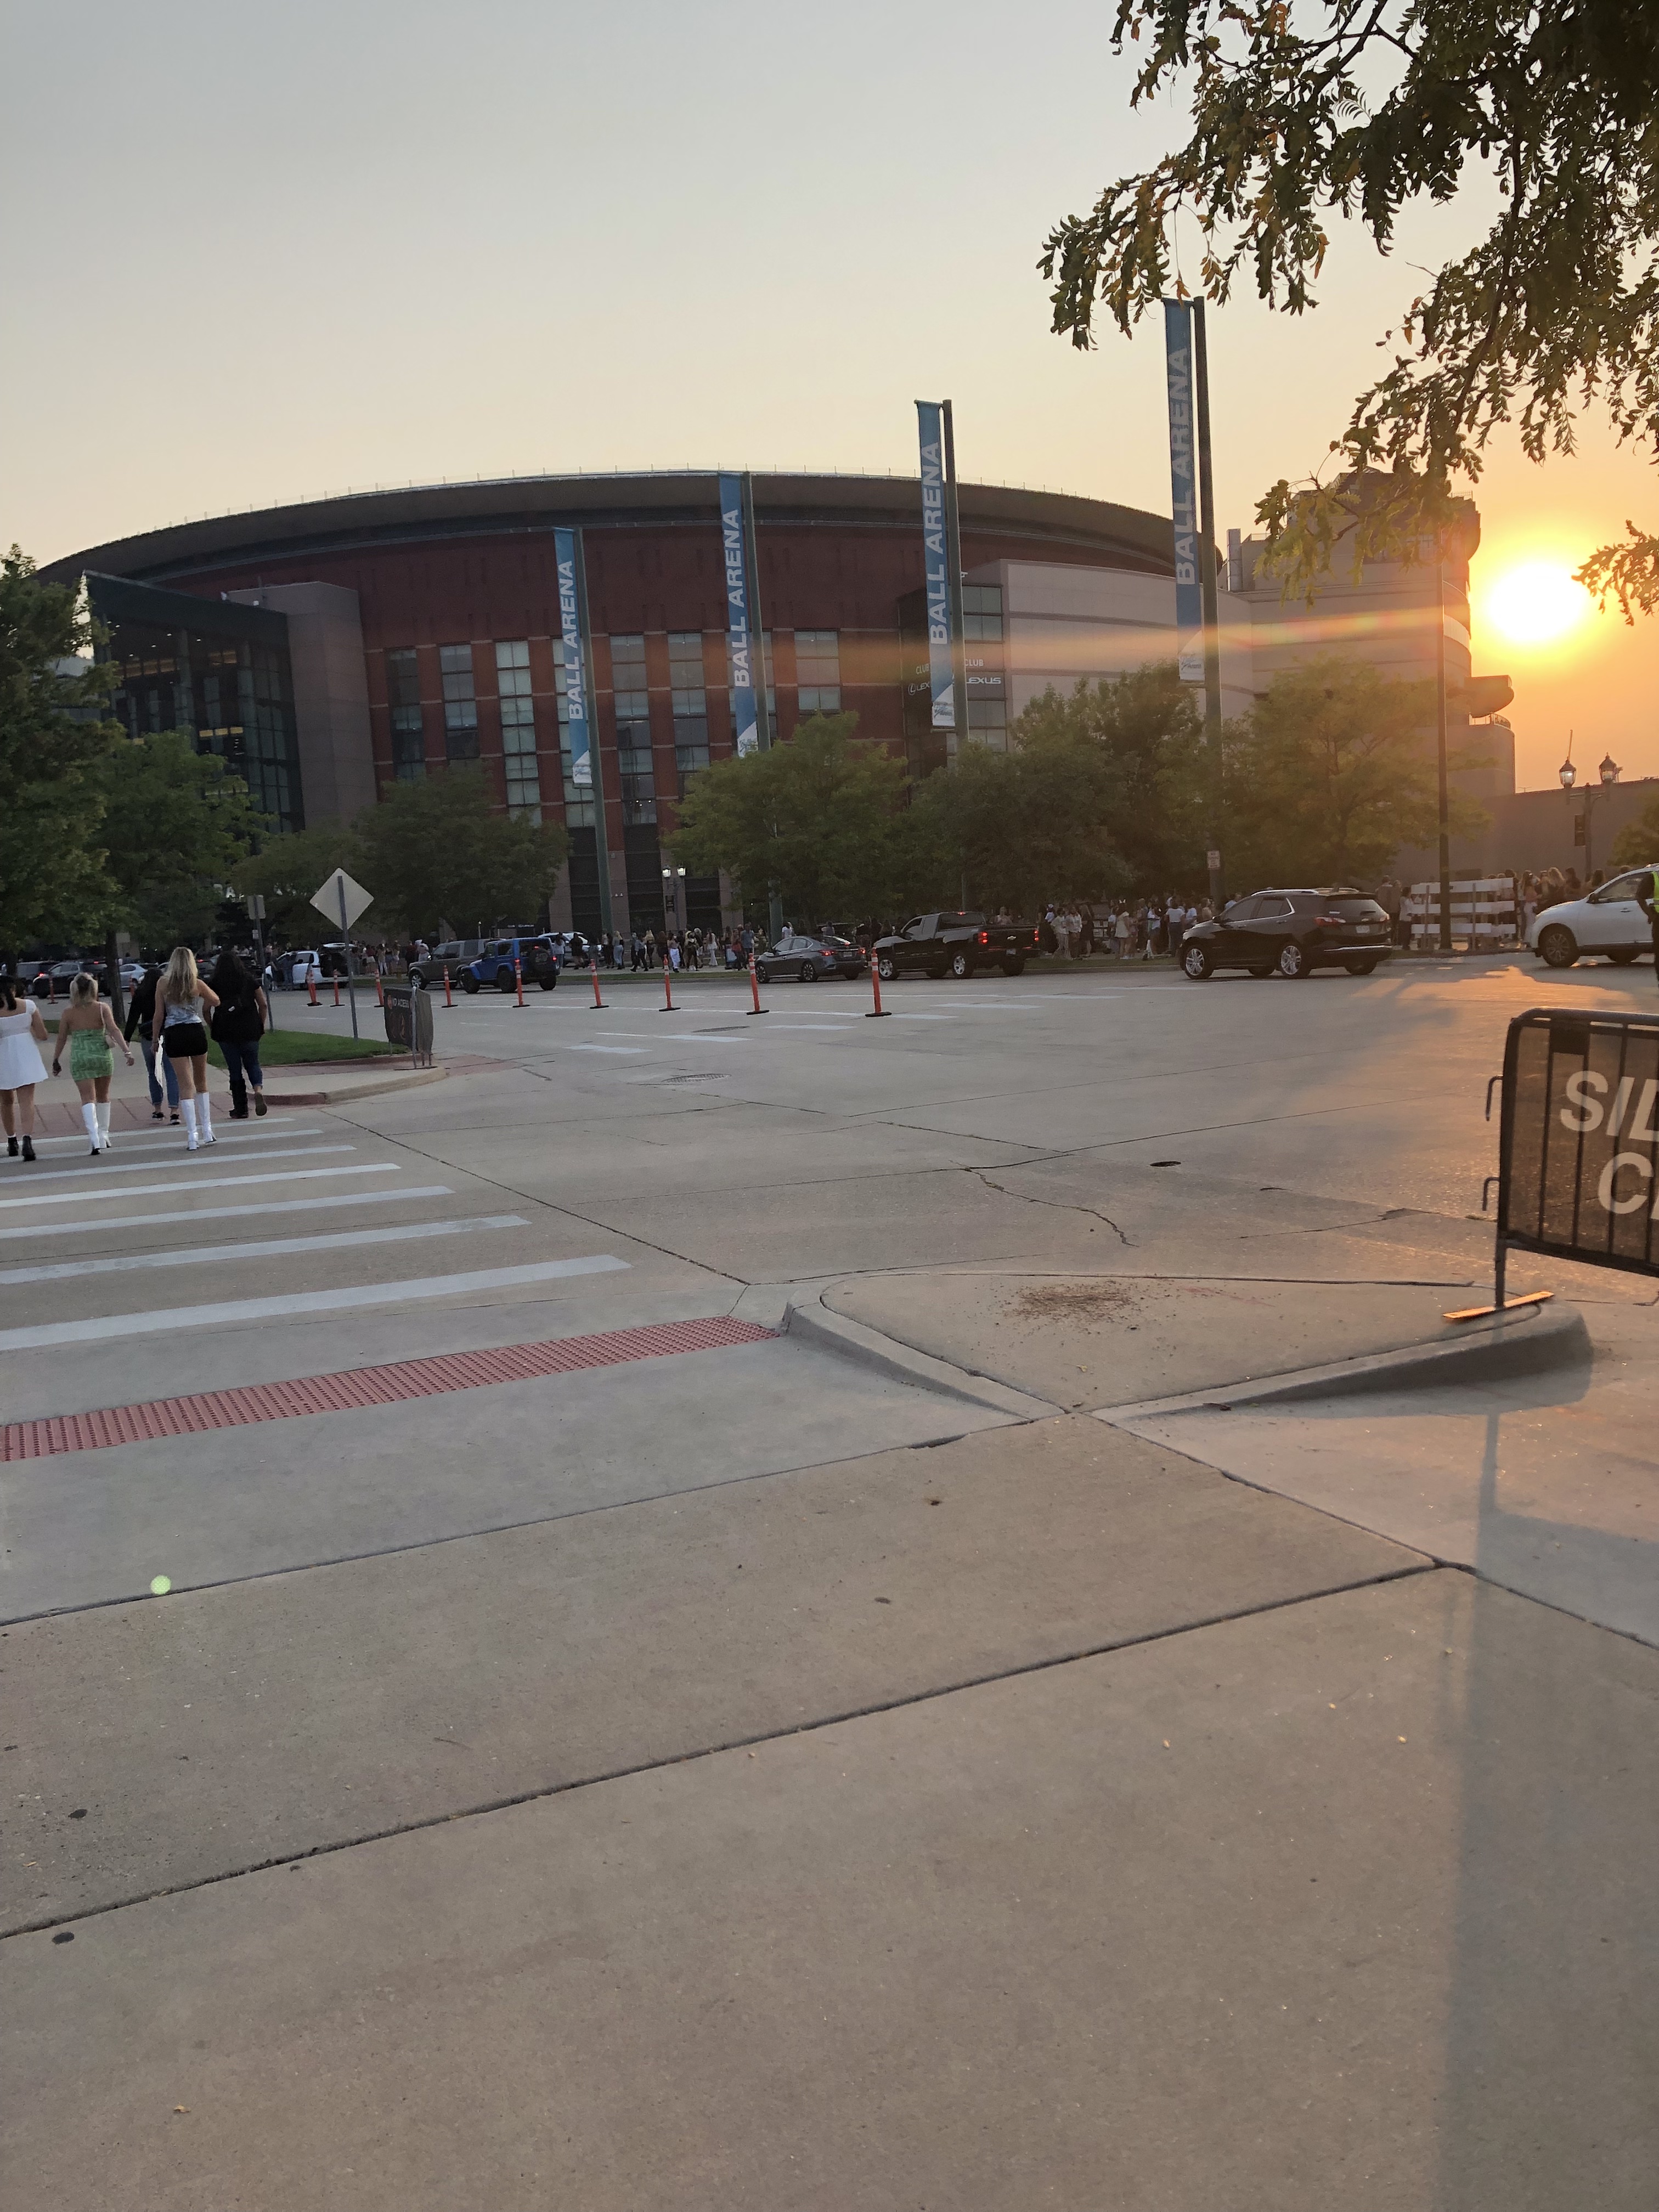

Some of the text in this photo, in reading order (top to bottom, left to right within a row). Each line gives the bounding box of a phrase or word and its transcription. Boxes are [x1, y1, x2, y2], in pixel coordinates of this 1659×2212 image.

[921, 442, 947, 645] BALL ARENA
[1168, 348, 1195, 585] BALL ARENA
[558, 561, 583, 719] BALL ARENA
[723, 509, 750, 687] BALL ARENA
[916, 663, 930, 675] CLUB
[964, 658, 984, 667] CLUB
[917, 681, 930, 691] LEX
